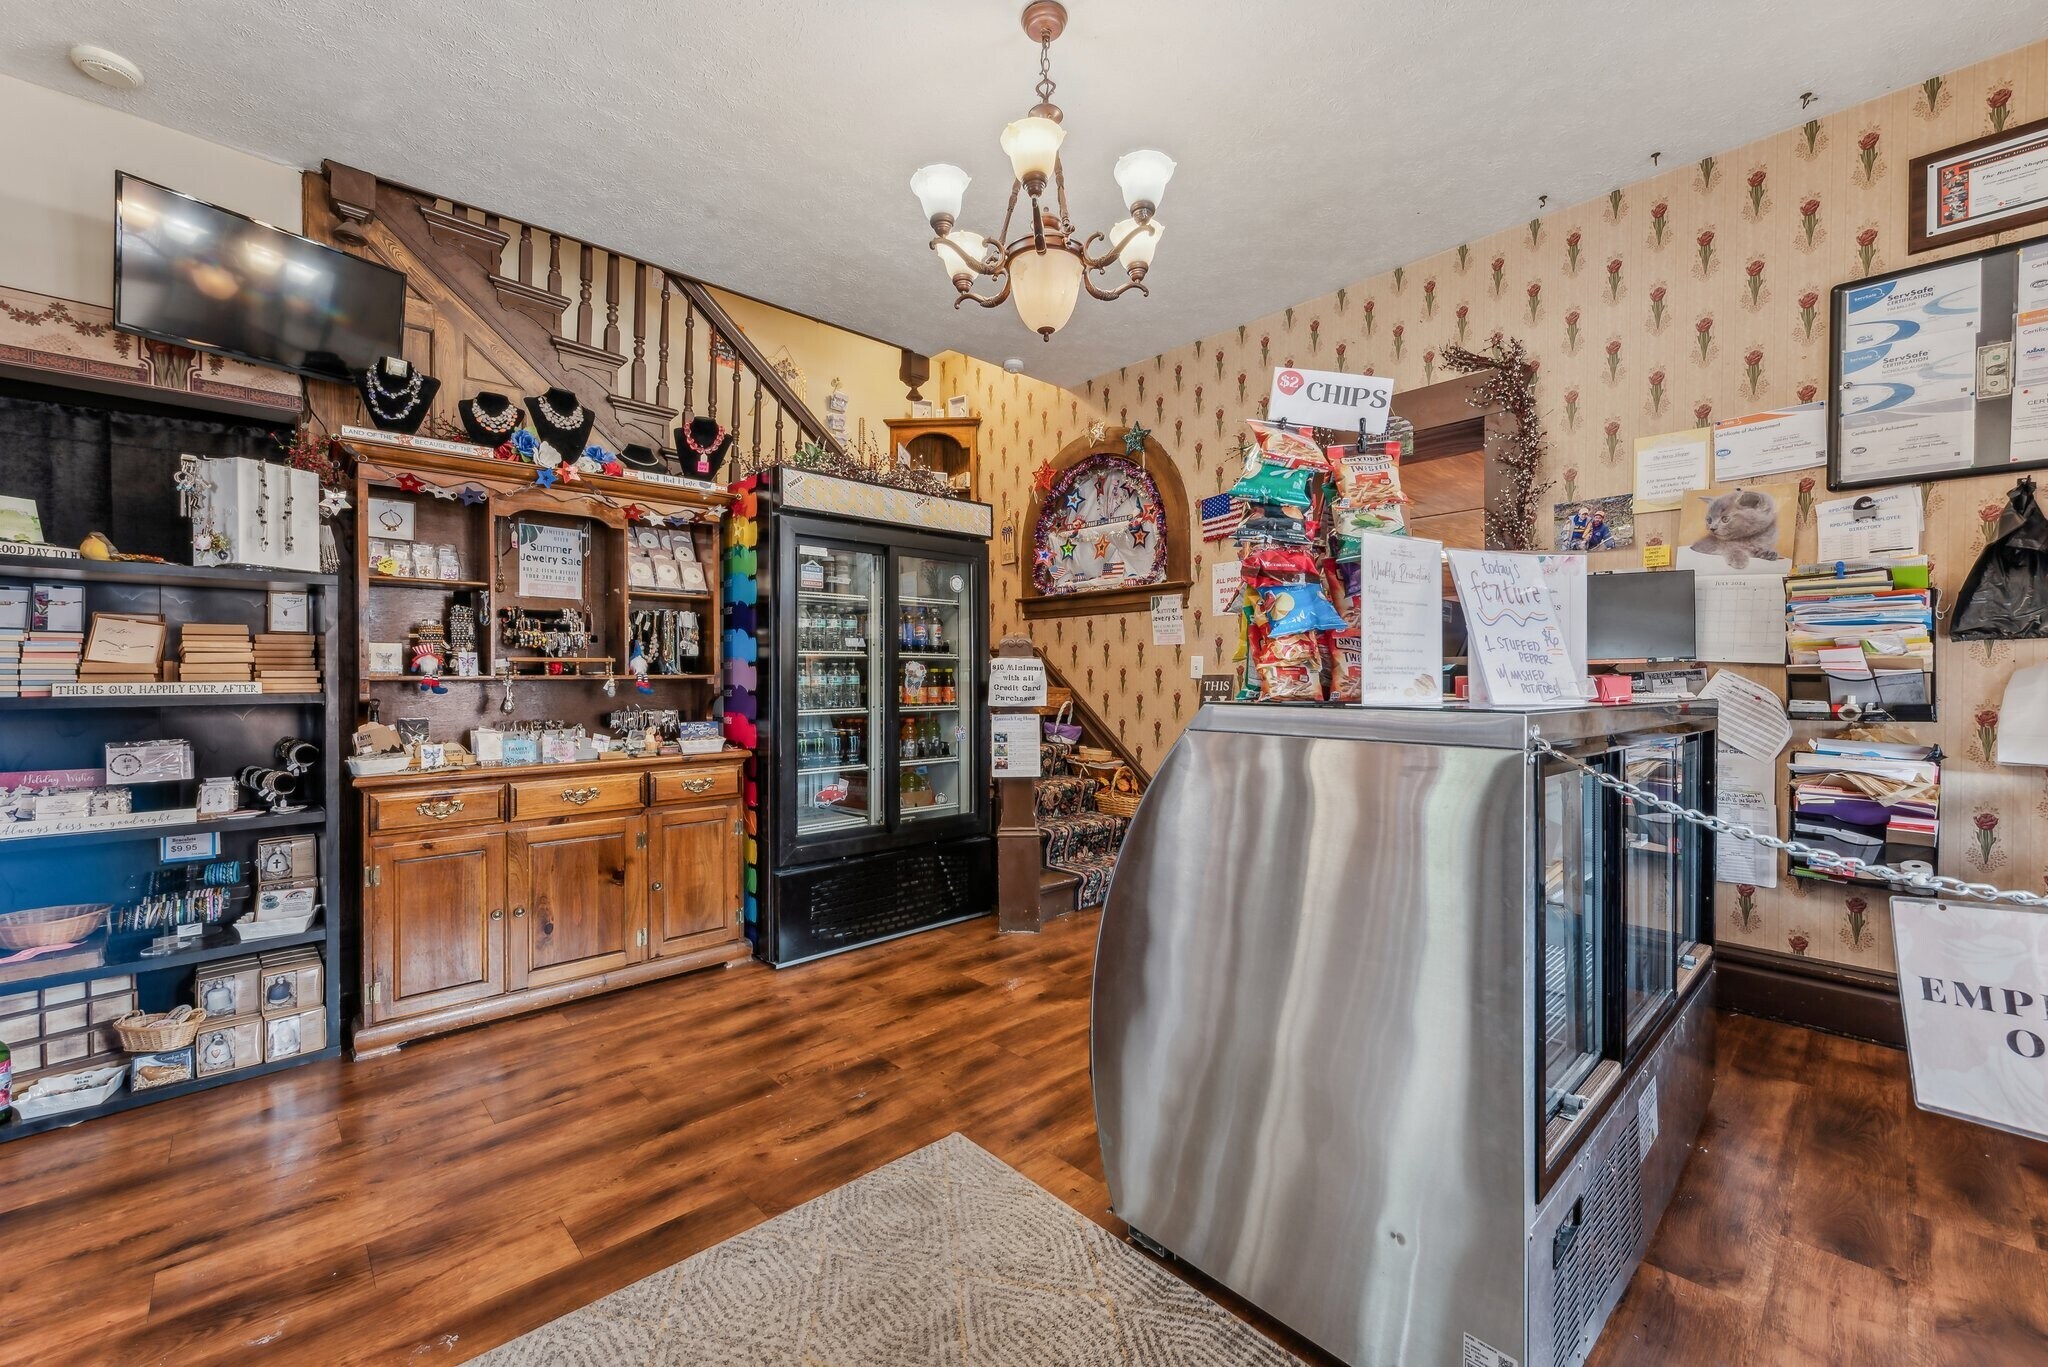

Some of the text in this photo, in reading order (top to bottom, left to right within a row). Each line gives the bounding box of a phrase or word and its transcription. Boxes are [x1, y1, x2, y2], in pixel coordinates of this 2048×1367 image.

[1886, 292, 1934, 306] CERTIFICATION
[1887, 286, 1934, 301] ServSafe
[1882, 350, 1929, 364] ServSafe
[1882, 356, 1929, 368] CERTIFICATION
[1279, 374, 1388, 408] $2 CHIPS
[1715, 430, 1741, 439] Certificate
[1747, 422, 1781, 432] Achievement
[1850, 428, 1877, 437] Certificate
[343, 428, 365, 436] LAND
[380, 433, 393, 441] THE
[414, 438, 446, 449] BECAUSE
[449, 443, 459, 451] OF
[460, 445, 473, 453] THE
[1848, 524, 1882, 532] DIRECTORY
[28, 546, 50, 557] DAY
[53, 549, 67, 559] TO
[530, 543, 572, 555] Summer
[520, 553, 582, 566] Jewelry Sale
[1480, 557, 1520, 585] today's
[1470, 569, 1541, 609] feature
[1496, 636, 1541, 652] STUFFED
[1518, 651, 1553, 665] PEPPER
[1510, 669, 1545, 681] MASHED
[55, 684, 259, 695] THIS IS OUR HAPPILY EVER AFTER
[993, 683, 1041, 692] Credit Card
[1203, 681, 1230, 691] THIS
[994, 694, 1036, 702] Purchases
[356, 733, 372, 741] FAITH
[22, 772, 95, 786] Holiday Wishes
[1, 813, 177, 837] Always kiss me goodnight
[170, 843, 198, 853] $9.95
[1918, 976, 2048, 1021] EMP
